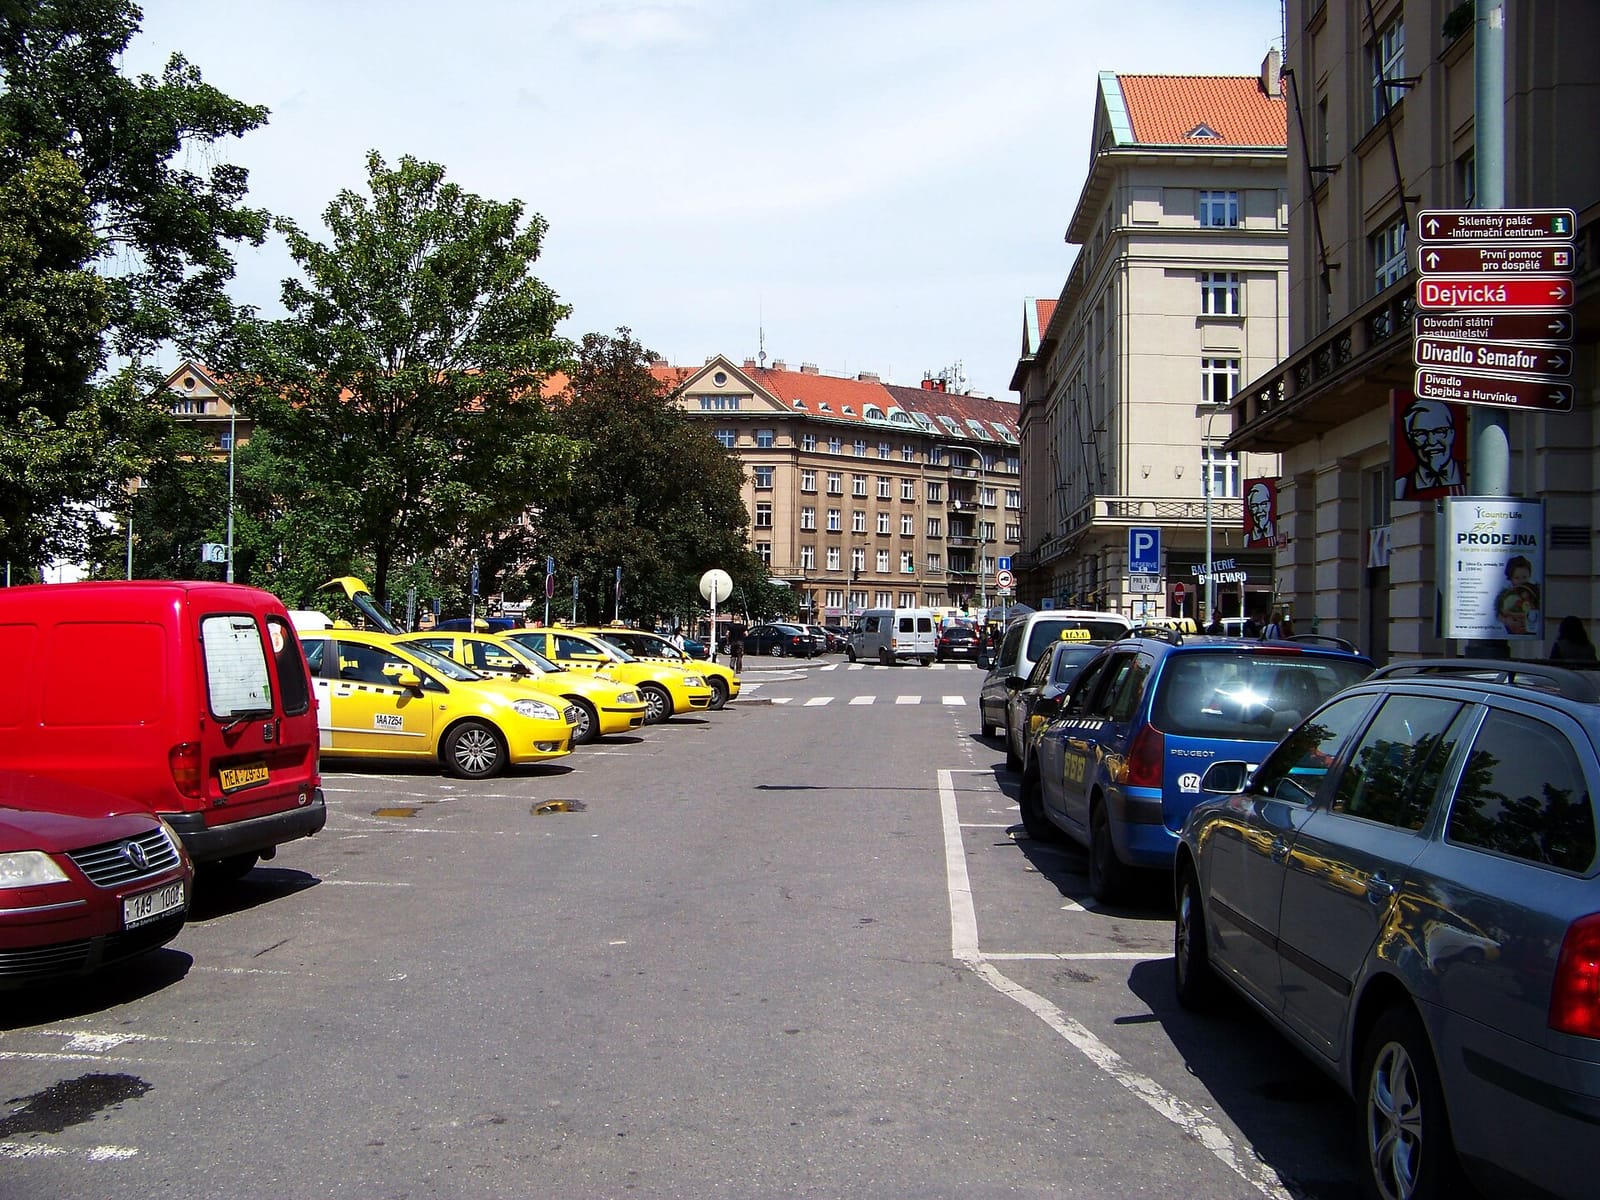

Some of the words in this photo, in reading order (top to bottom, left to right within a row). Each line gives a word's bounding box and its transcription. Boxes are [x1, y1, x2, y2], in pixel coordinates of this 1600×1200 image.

[1458, 216, 1506, 228] Skleněný
[1506, 216, 1533, 227] palác
[1480, 249, 1506, 260] První
[1508, 251, 1542, 261] pomoc
[1482, 262, 1499, 272] pro
[1501, 260, 1540, 272] dospělé
[1426, 285, 1506, 306] Dejvická
[1423, 317, 1463, 328] Obvodní
[1465, 317, 1494, 327] státní
[1423, 328, 1489, 338] zastupitelství
[1422, 342, 1473, 364] Divadlo
[1477, 347, 1538, 369] Semafor
[1425, 373, 1462, 387] Divadlo
[1424, 384, 1461, 398] Spejbla
[1463, 390, 1470, 398] a
[1472, 389, 1518, 403] Hurvínka
[1135, 533, 1154, 559] P
[1457, 533, 1537, 547] PRODEJNA
[1065, 631, 1088, 639] TAXI
[1170, 749, 1216, 757] PEUGEOT
[1183, 775, 1198, 788] CZ
[134, 895, 152, 918] 1A9
